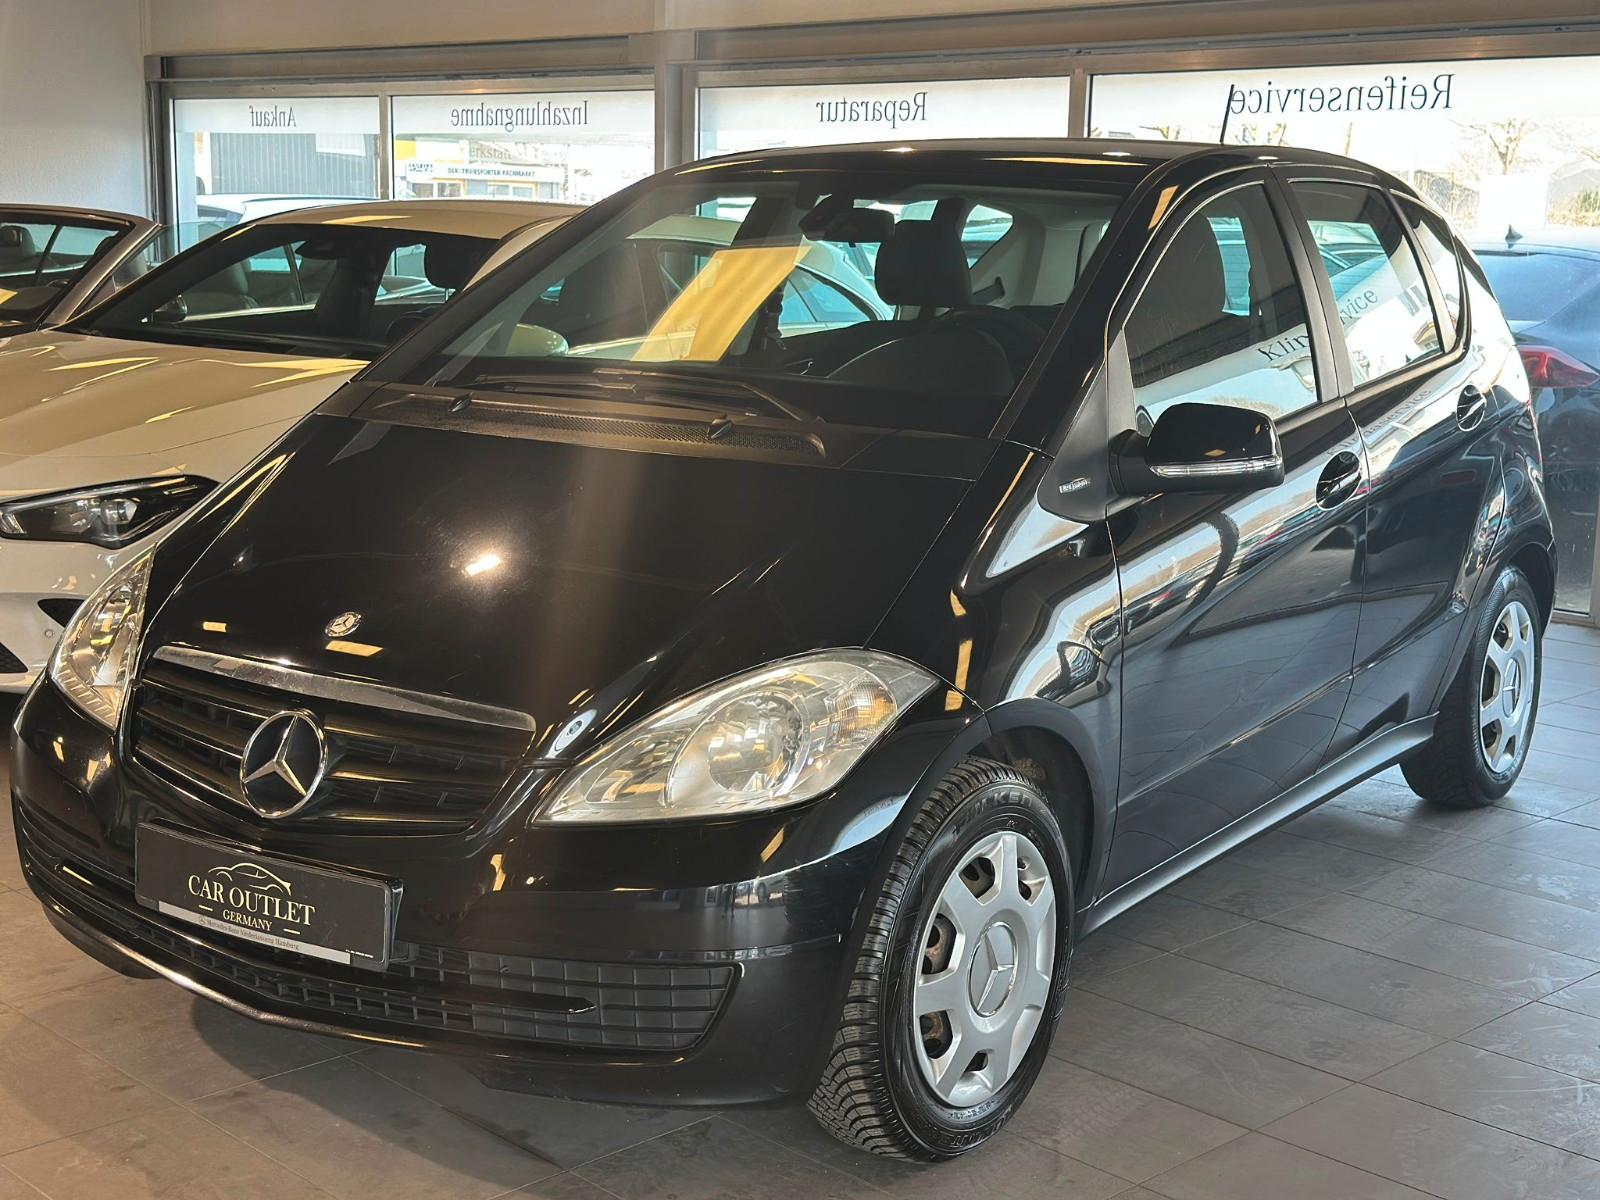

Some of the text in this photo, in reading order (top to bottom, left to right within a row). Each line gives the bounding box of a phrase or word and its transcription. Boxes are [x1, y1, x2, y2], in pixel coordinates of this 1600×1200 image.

[188, 874, 316, 926] CAR OUTLET
[222, 908, 273, 932] GERMANY
